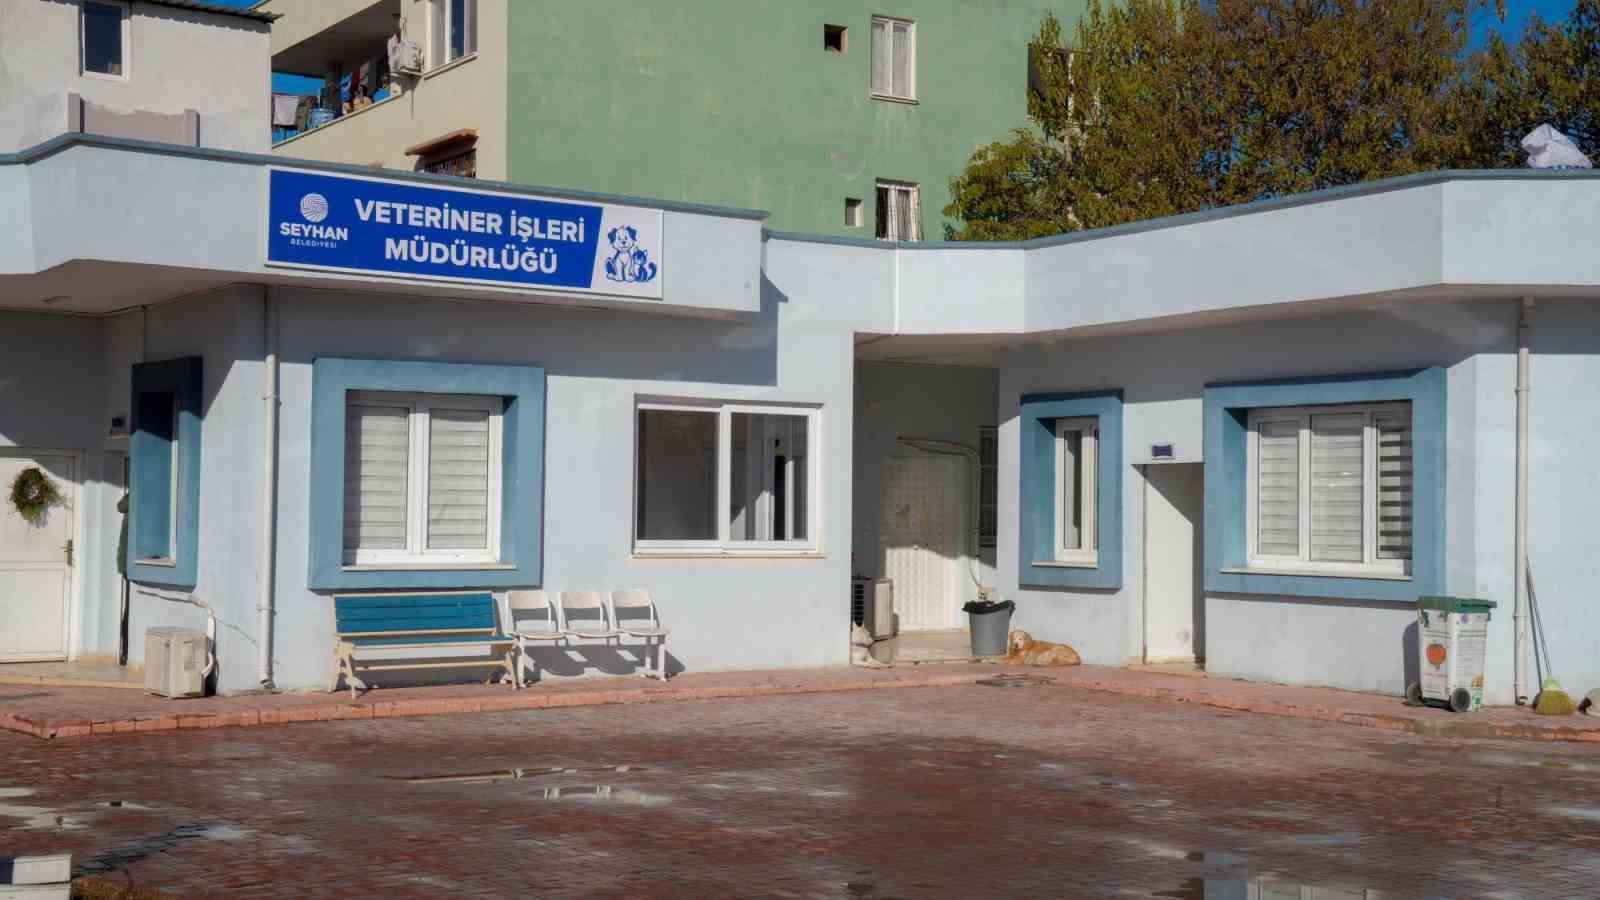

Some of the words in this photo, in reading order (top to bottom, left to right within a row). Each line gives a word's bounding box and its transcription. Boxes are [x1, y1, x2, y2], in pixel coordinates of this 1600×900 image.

[280, 222, 348, 240] SEYHAN
[354, 198, 502, 235] VETERİNER
[510, 209, 585, 243] İŞLERİ
[384, 235, 557, 274] MÜDÜRLÜĞÜ
